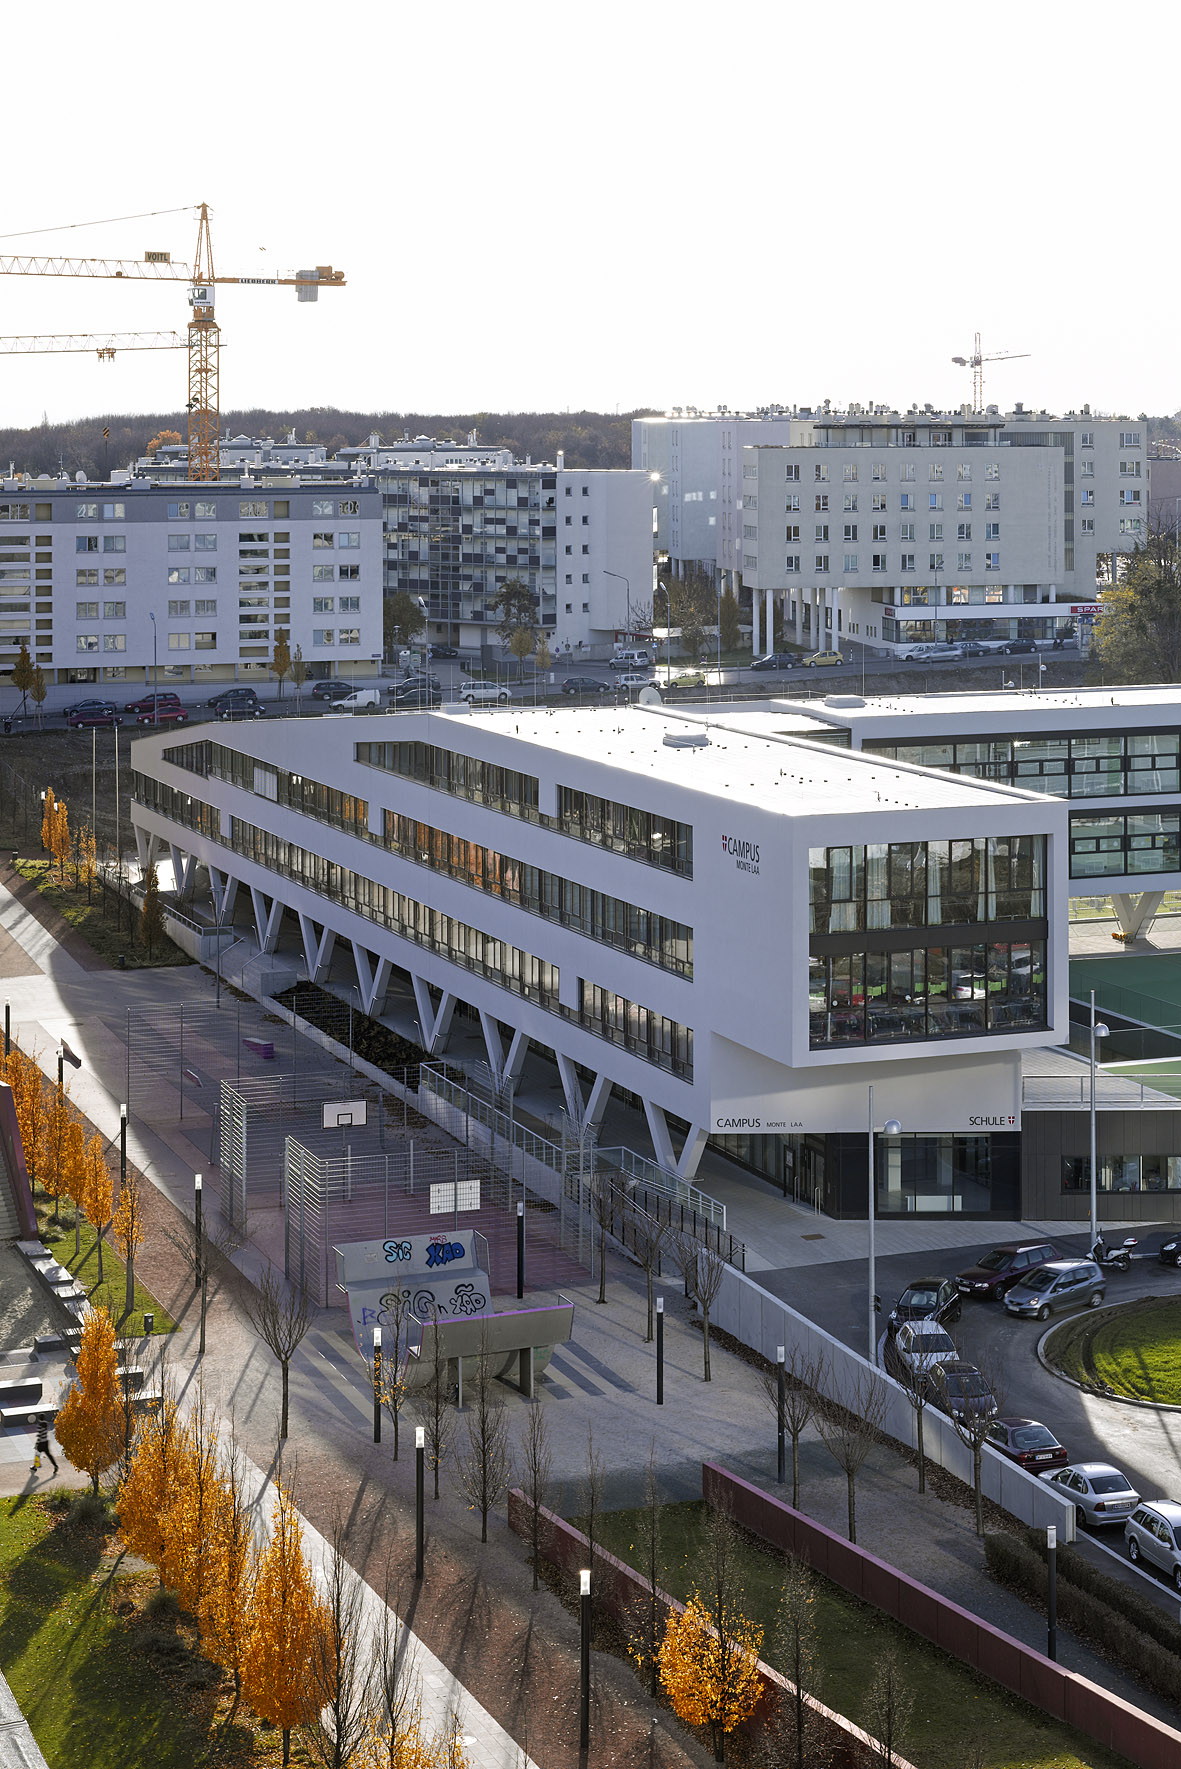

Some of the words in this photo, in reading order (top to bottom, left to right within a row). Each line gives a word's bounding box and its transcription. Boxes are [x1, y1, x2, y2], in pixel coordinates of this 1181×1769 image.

[147, 251, 168, 261] VOITL
[727, 836, 760, 864] CAMPUS
[736, 859, 751, 873] MONTE
[751, 864, 760, 875] LAA
[716, 1118, 761, 1128] CAMPUS
[969, 1116, 1005, 1126] SCHULE
